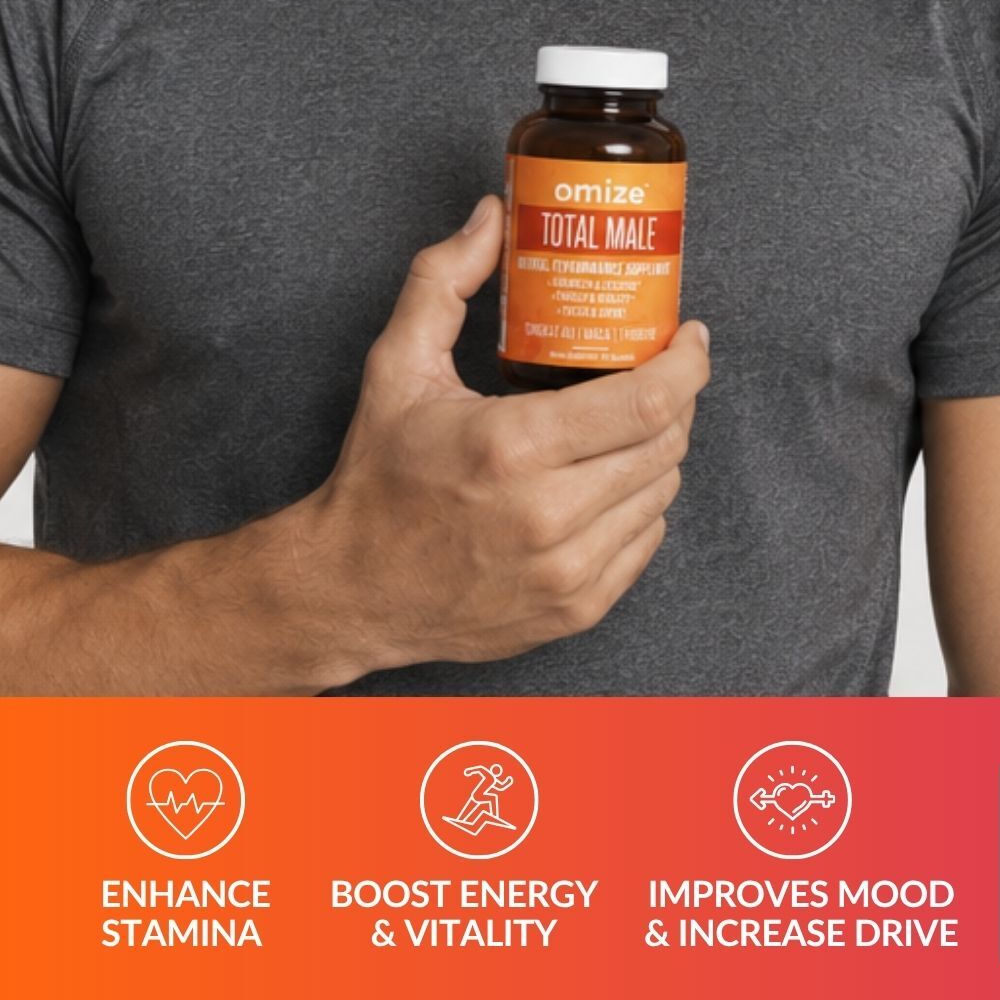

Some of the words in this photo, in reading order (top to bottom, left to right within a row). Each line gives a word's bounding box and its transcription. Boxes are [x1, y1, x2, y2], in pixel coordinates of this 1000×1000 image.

[554, 178, 646, 204] omize
[541, 212, 599, 249] TOTAL
[605, 215, 658, 251] MALE
